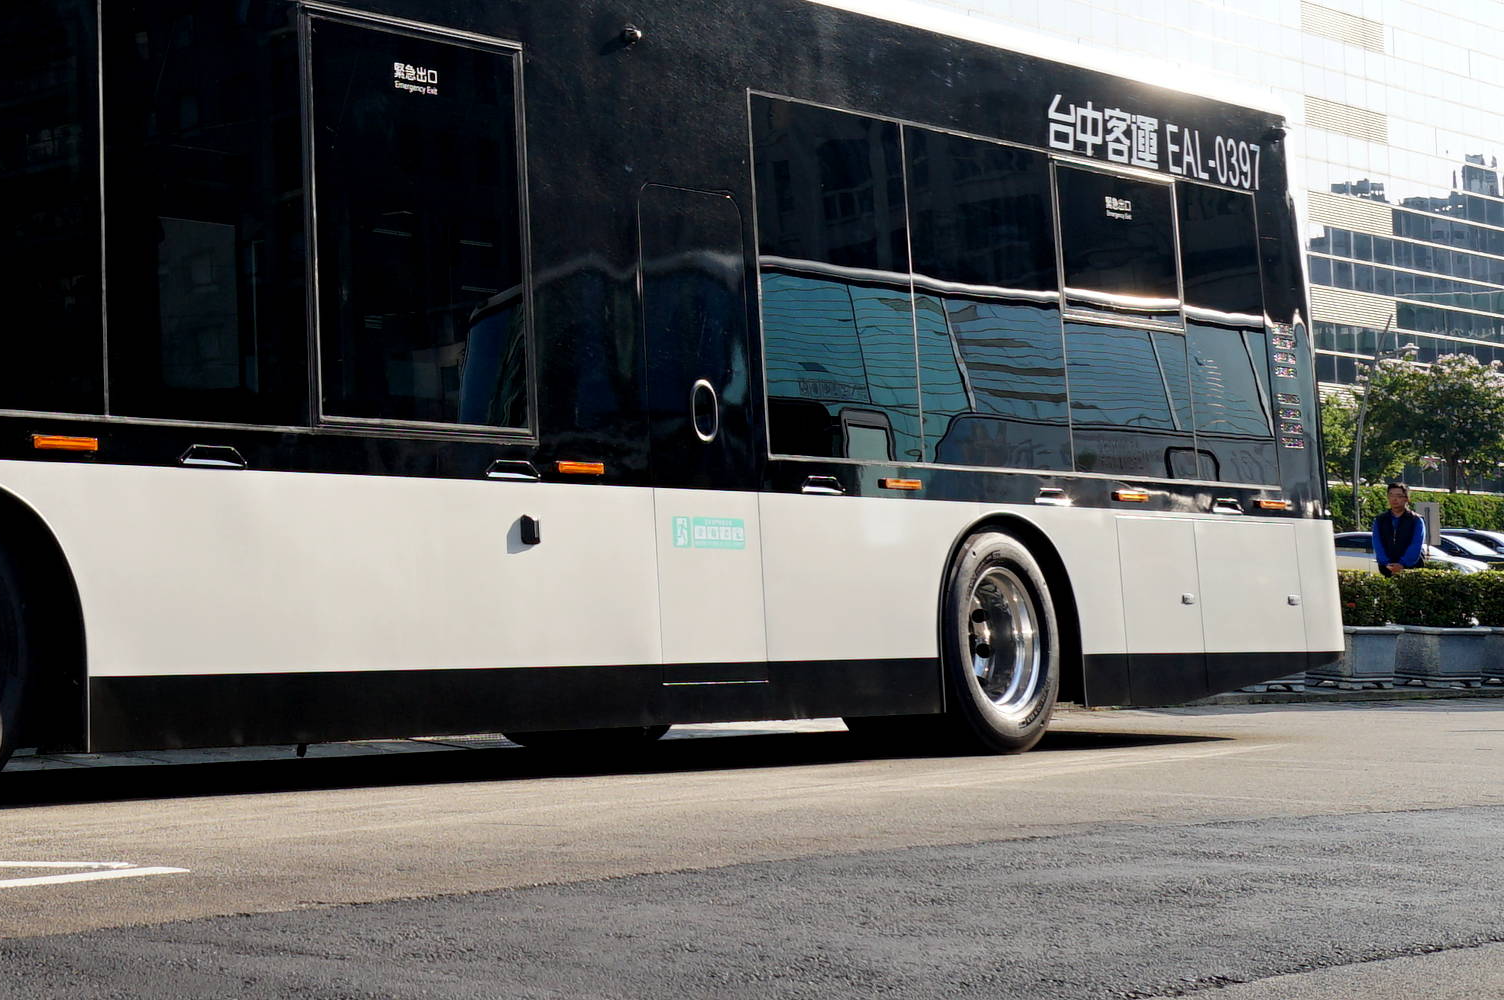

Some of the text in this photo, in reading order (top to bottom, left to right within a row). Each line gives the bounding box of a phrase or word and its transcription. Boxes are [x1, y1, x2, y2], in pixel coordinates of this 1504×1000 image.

[394, 62, 438, 84] 緊急出口
[394, 81, 438, 95] Emergency Exit
[1048, 94, 1261, 190] 台中客運 EAL-0397
